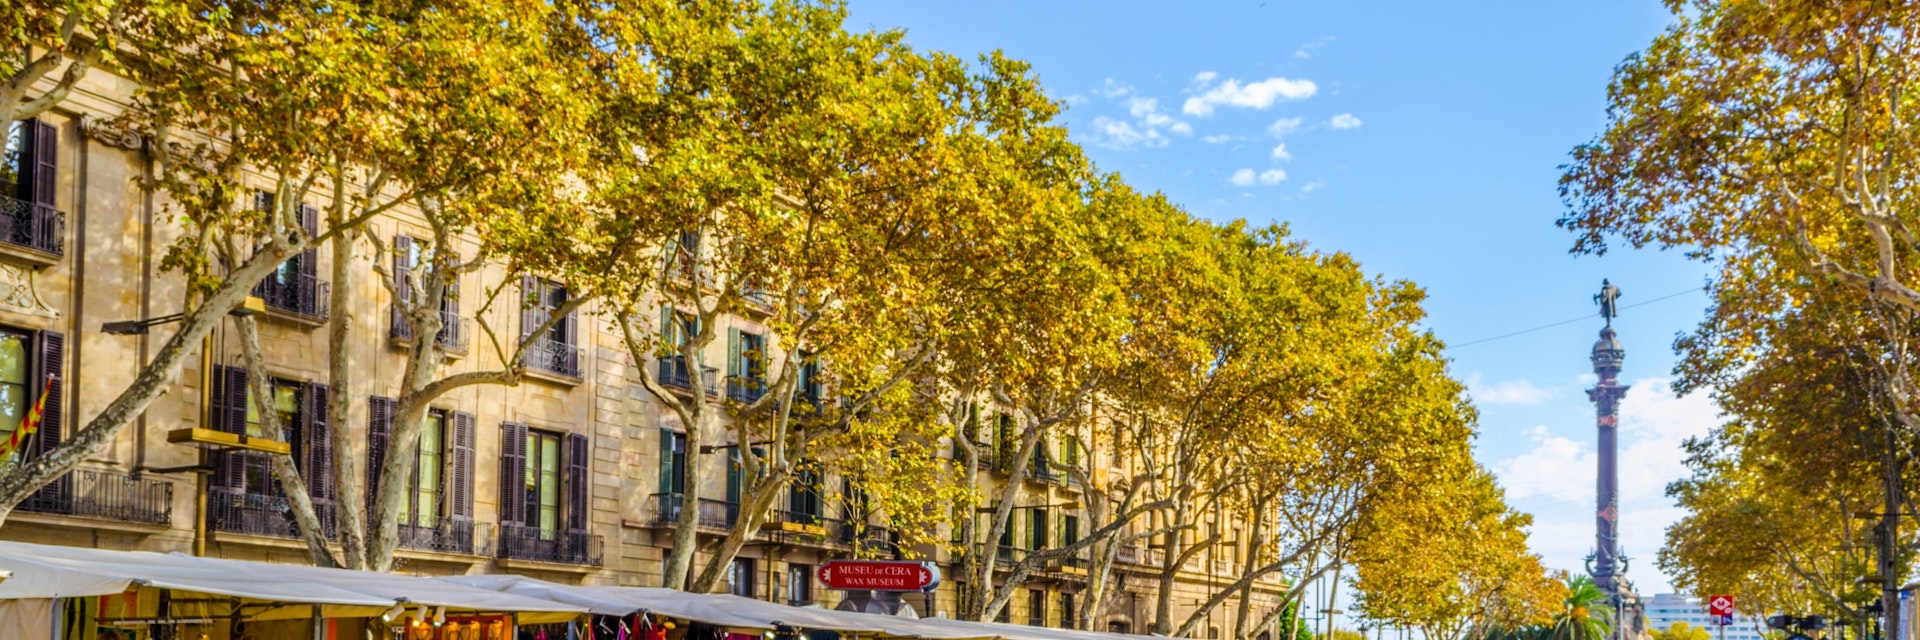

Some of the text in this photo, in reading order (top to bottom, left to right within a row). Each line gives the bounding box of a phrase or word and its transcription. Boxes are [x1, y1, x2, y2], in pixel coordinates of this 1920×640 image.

[838, 565, 874, 575] MUSEU
[884, 566, 911, 576] CERA
[845, 577, 904, 586] WAX MUSEUM
